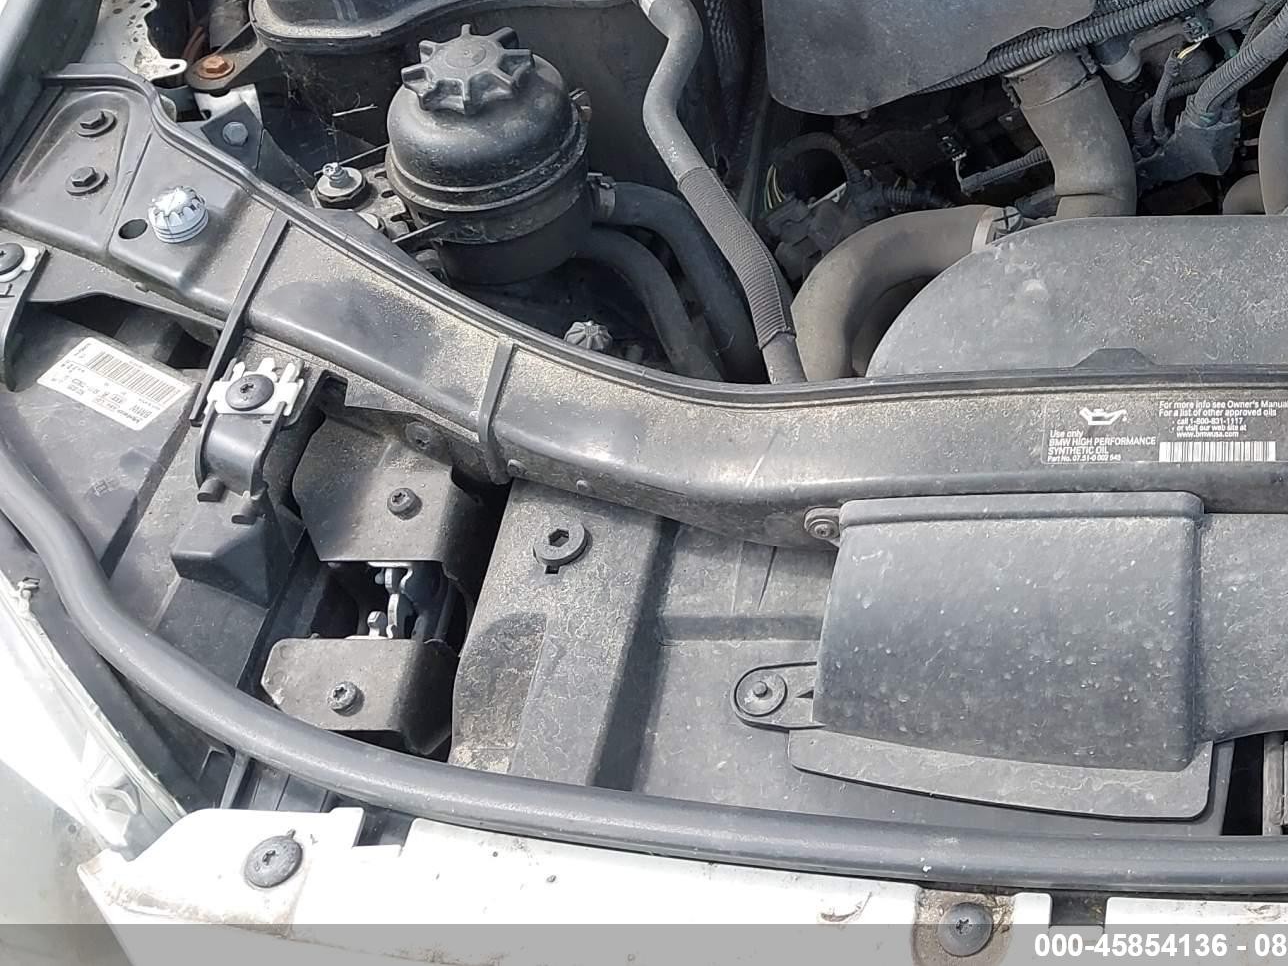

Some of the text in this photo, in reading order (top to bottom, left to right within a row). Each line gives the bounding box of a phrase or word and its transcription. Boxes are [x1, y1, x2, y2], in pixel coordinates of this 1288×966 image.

[1227, 400, 1259, 408] Owner's
[1261, 400, 1288, 408] Manual
[1225, 409, 1261, 417] approved
[1050, 430, 1083, 439] Use only
[1049, 436, 1156, 446] BMW HIGH PERFORMANCE
[1048, 446, 1109, 455] SYNTHETIC OIL
